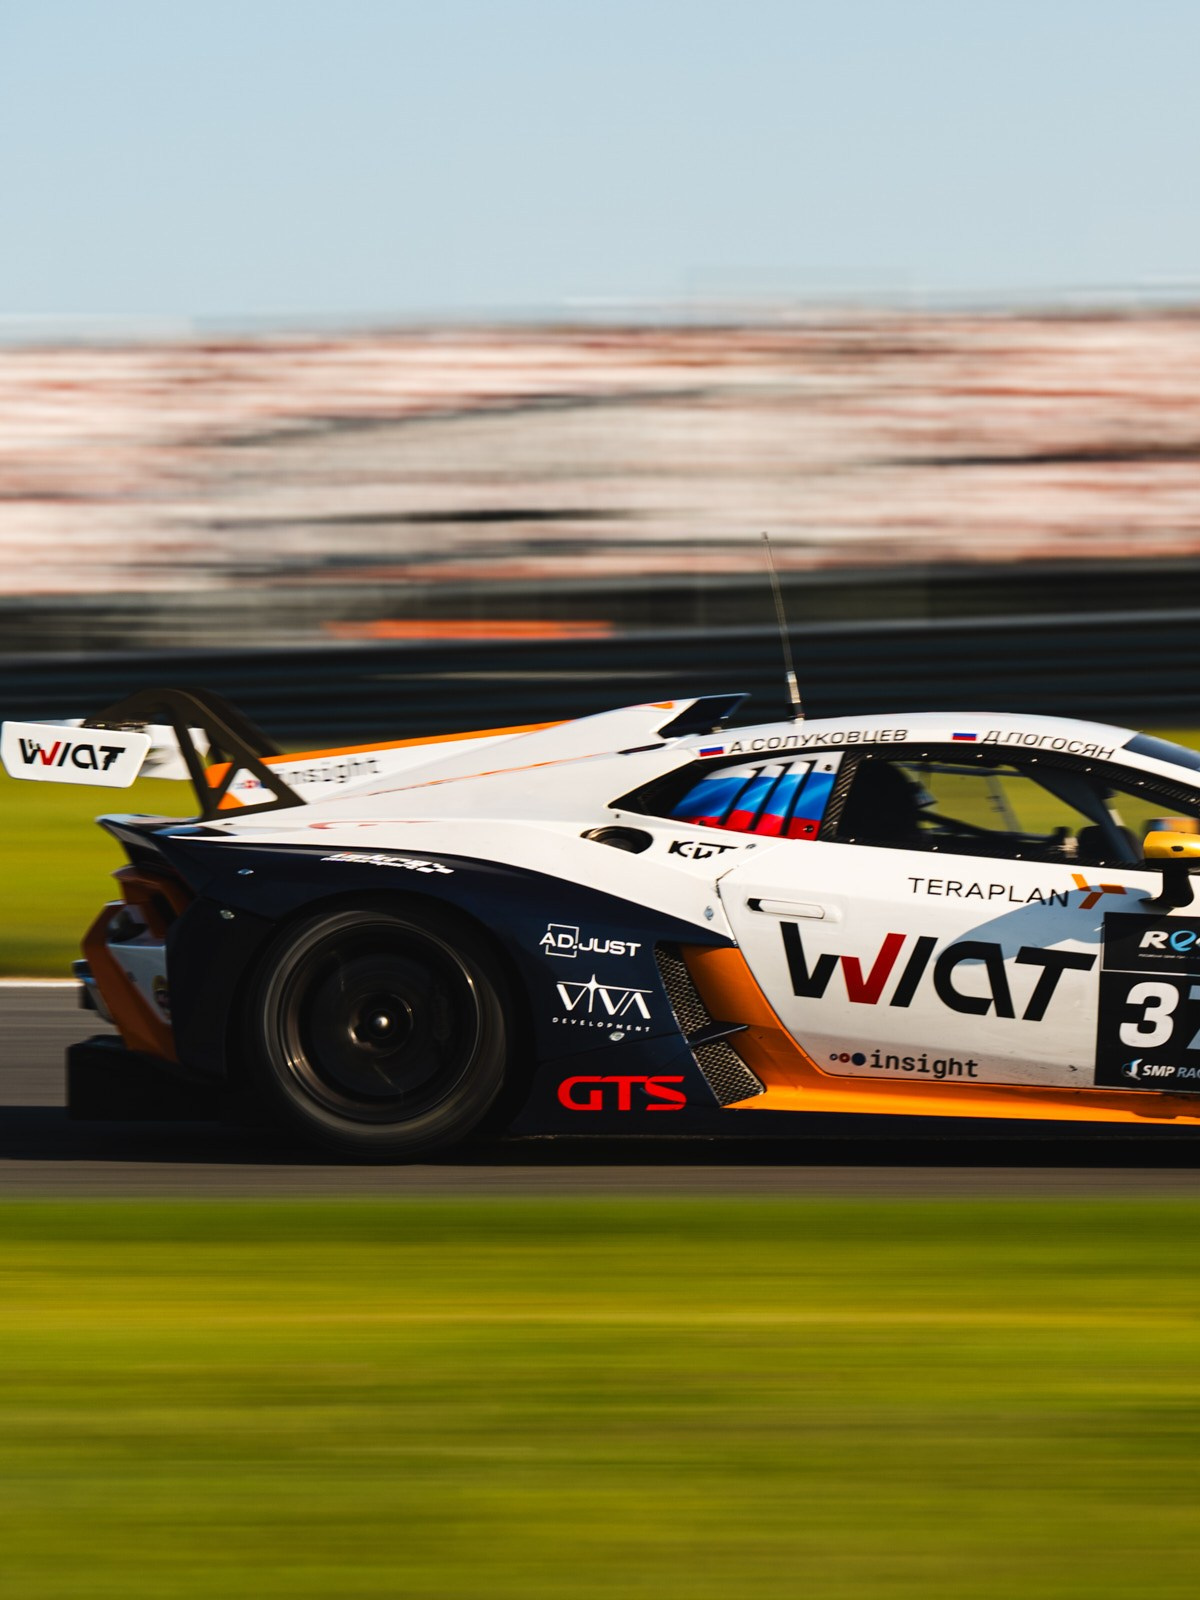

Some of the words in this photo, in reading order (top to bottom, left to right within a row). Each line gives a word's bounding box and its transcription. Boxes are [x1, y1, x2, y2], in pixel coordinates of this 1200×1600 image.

[729, 729, 909, 754] А.СОЛУКОВЦЕВ
[908, 876, 1071, 908] TERAPLAN
[779, 920, 1098, 1022] WIAT
[556, 973, 654, 1020] VIVA
[551, 1016, 651, 1033] DEVELOPMENT
[869, 1049, 980, 1080] insight
[1141, 1063, 1176, 1079] SMP
[557, 1075, 688, 1111] GTS
